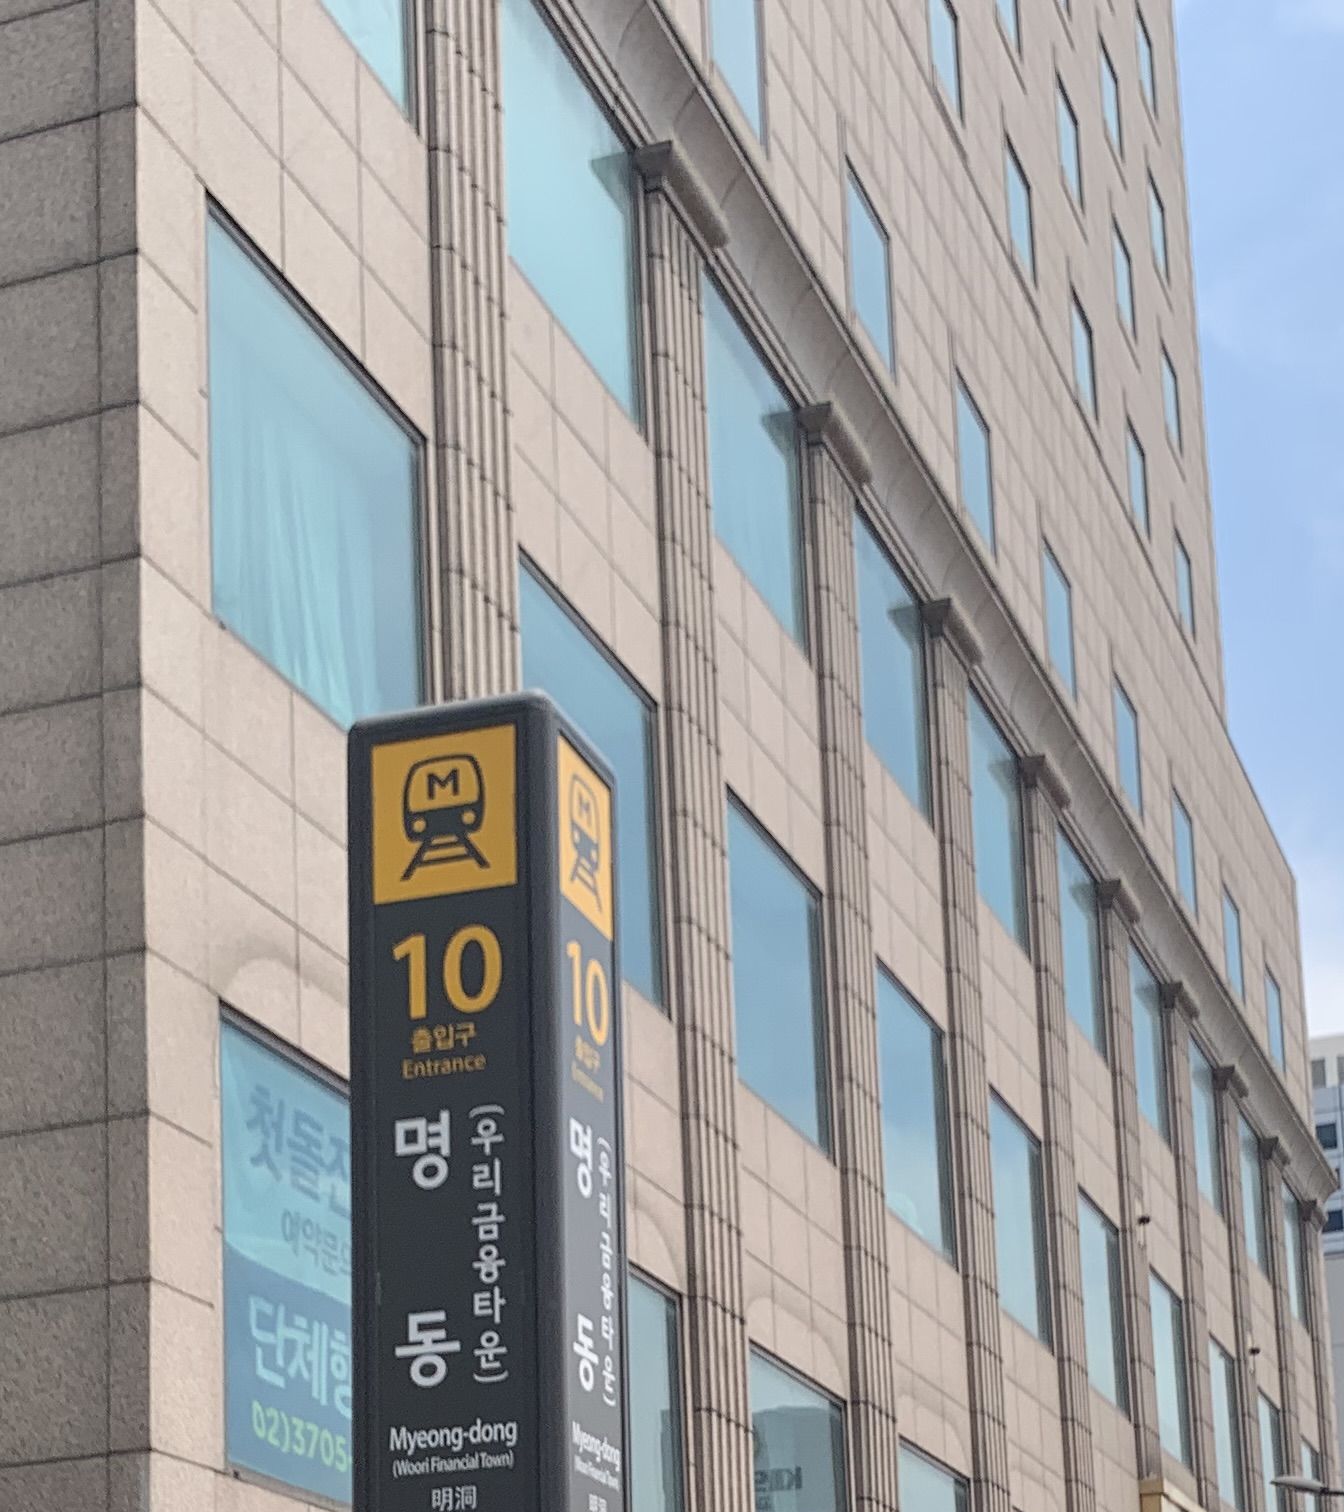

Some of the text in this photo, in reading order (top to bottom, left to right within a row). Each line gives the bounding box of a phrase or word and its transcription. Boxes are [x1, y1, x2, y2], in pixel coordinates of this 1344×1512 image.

[392, 923, 503, 1021] 10
[566, 939, 610, 1047] 10
[410, 1022, 478, 1054] 출입구
[401, 1053, 487, 1080] Entrance
[394, 1108, 462, 1389] 명동
[568, 1117, 600, 1393] 명동
[389, 1417, 518, 1457] Myeong-dong
[431, 1451, 480, 1474] Financial
[431, 1484, 477, 1512] 明洞
